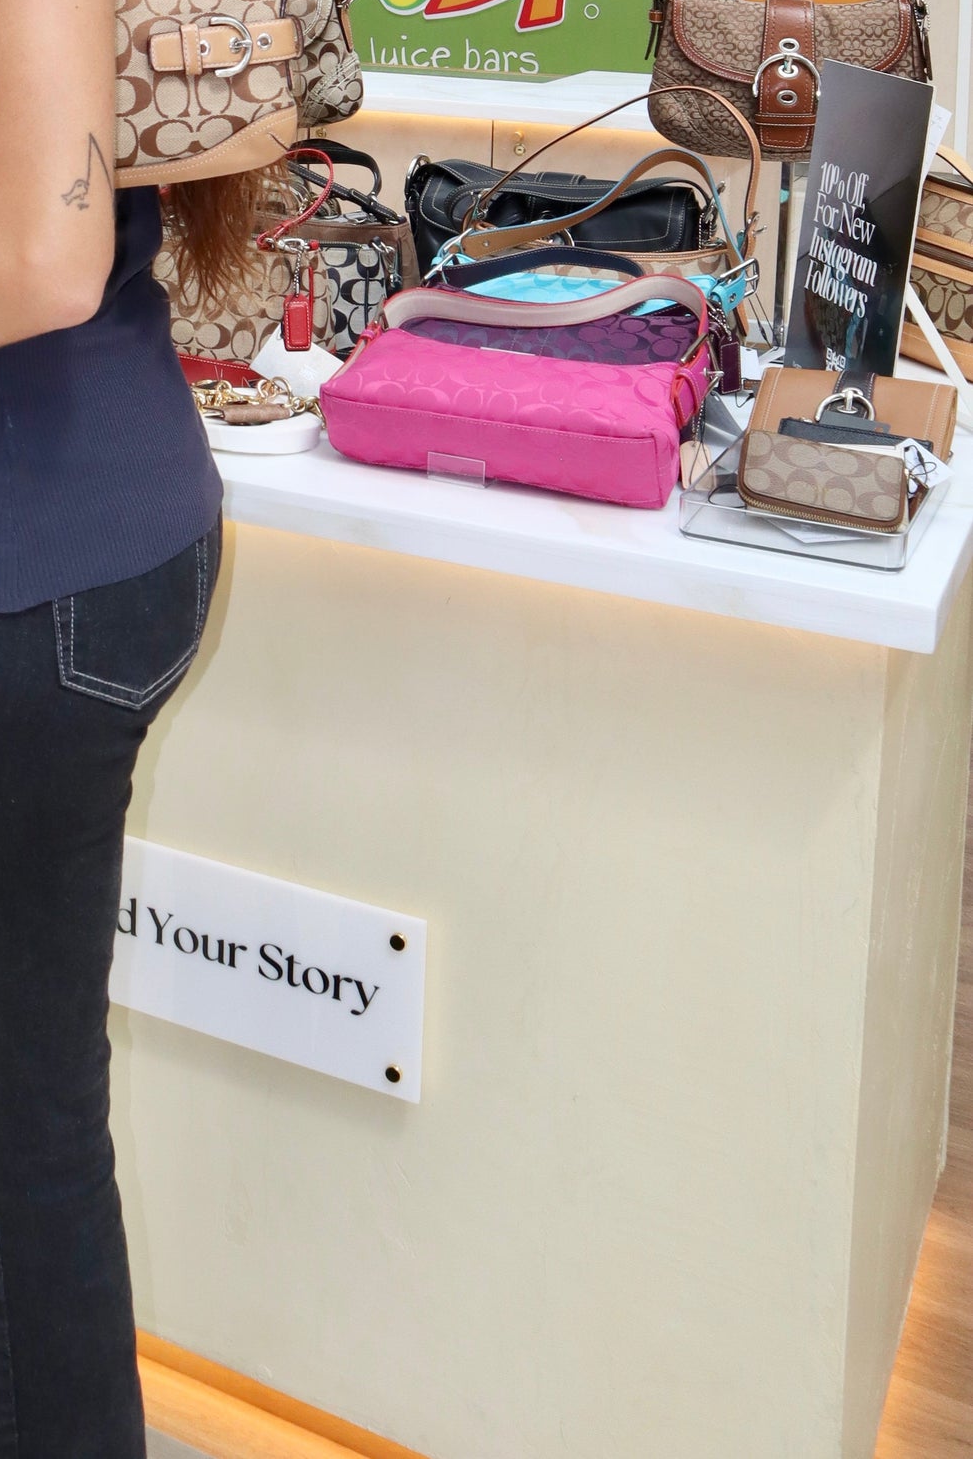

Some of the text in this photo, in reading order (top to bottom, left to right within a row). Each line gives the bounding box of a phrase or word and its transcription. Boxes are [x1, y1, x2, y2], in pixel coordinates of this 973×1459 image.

[463, 38, 539, 74] bars
[821, 161, 844, 200] 10%
[814, 192, 876, 246] For New
[809, 227, 878, 288] Instagram
[804, 260, 868, 319] Followers
[146, 906, 248, 969] Your
[258, 943, 380, 1016] Story
